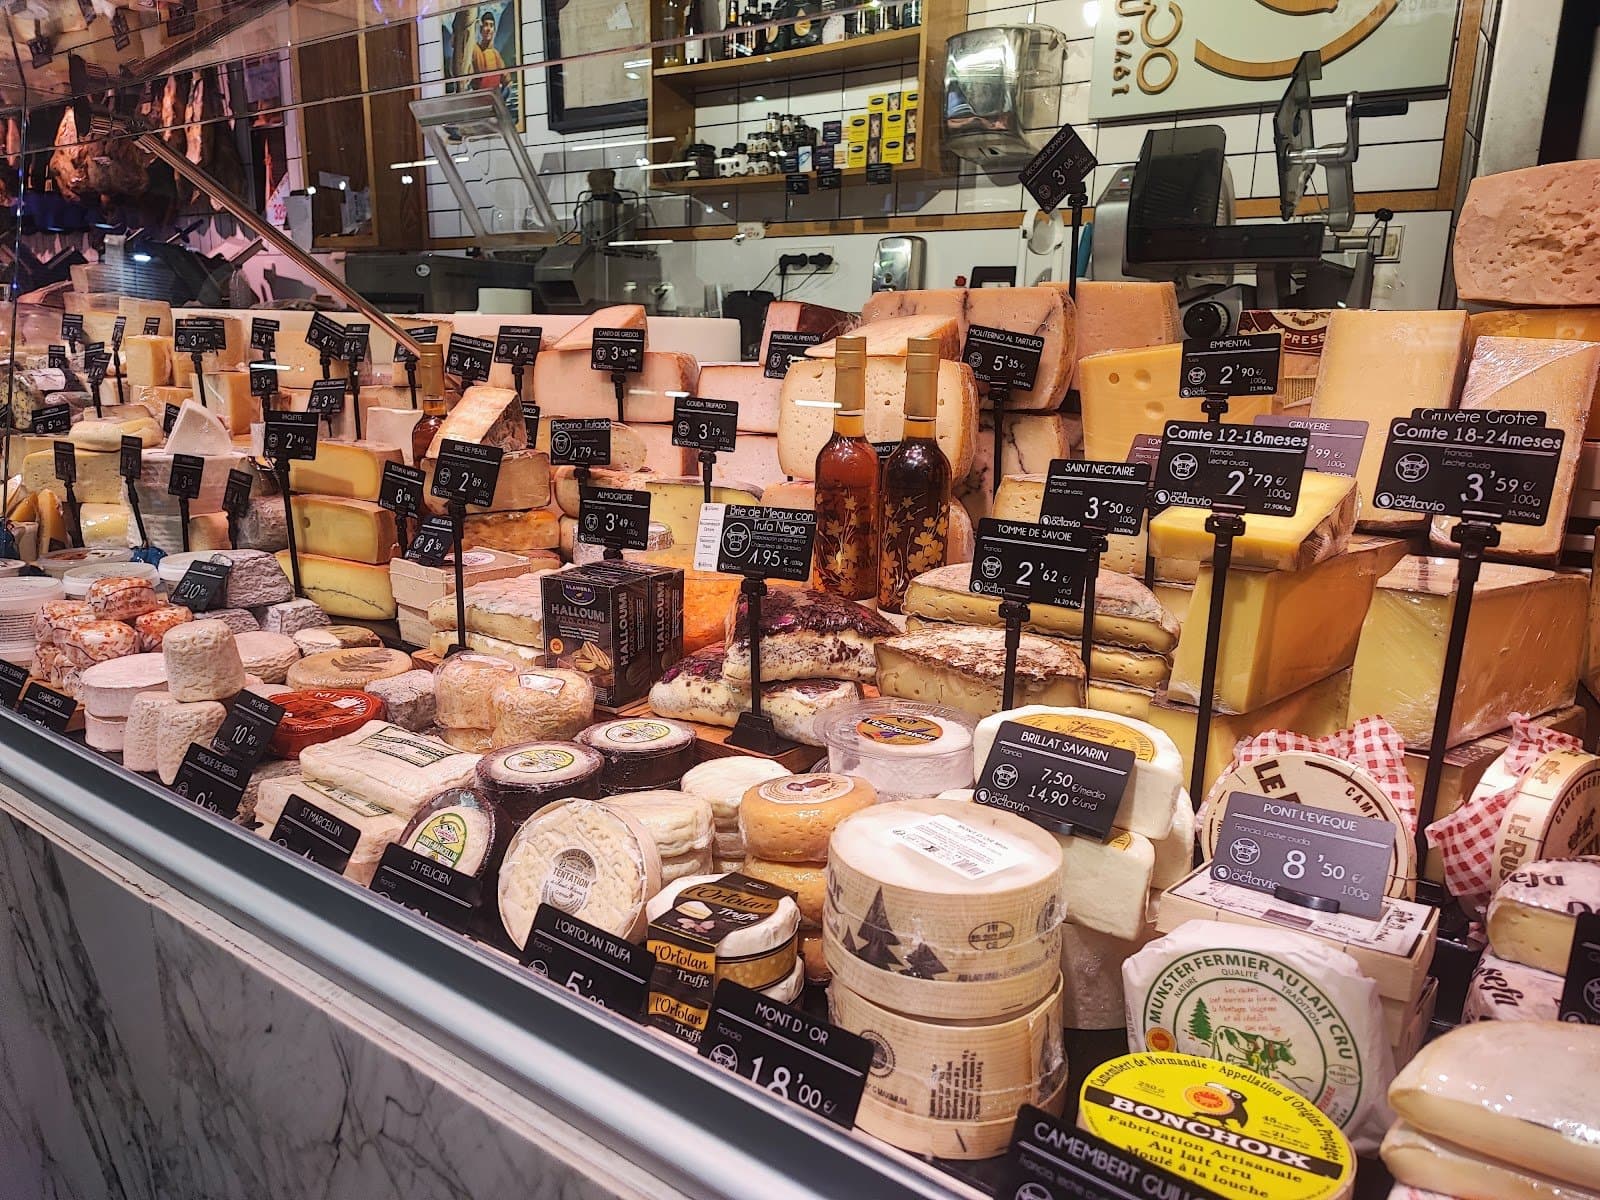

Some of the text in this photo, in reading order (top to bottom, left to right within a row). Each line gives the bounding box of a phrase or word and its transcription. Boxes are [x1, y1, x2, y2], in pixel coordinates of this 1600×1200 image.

[1112, 31, 1134, 97] 1970
[970, 329, 1005, 341] MOLITERNO
[1015, 336, 1042, 348] TARTUFO
[1210, 339, 1252, 349] EMMENTAL
[992, 355, 1019, 371] 5'35
[1219, 364, 1255, 385] 2'90
[1250, 377, 1266, 385] 100g
[705, 402, 727, 410] TRUFADO
[584, 420, 611, 430] Trufado
[698, 422, 721, 440] 3'19
[1288, 421, 1331, 431] GRUYERE
[1167, 425, 1308, 448] Comte 12-18meses
[1393, 423, 1562, 450] Comte 18-24meses
[1065, 463, 1135, 477] SAINT NECTAIRE
[1208, 457, 1228, 465] Leche
[1327, 460, 1345, 469] 100g
[1441, 457, 1466, 467] Leche
[459, 472, 481, 492] 2'89
[1225, 468, 1273, 496] 2'79
[1460, 471, 1519, 502] 3'59
[1169, 492, 1212, 506] octavio
[1266, 488, 1292, 500] 100g
[1394, 496, 1446, 512] octavio
[1511, 493, 1541, 507] 100g
[605, 513, 629, 532] 3'49
[729, 505, 814, 521] Brie de Meaux con
[1051, 517, 1081, 528] octavio
[1118, 515, 1137, 525] 100g
[753, 520, 806, 535] Trufa Negra
[997, 524, 1073, 542] TOMME DE SAVOIE
[1016, 561, 1058, 586] 2'62
[1058, 587, 1072, 596] und
[551, 603, 605, 622] HALLOUMI
[657, 581, 665, 652] HALLOUMI
[619, 592, 628, 666] HALLOUMI
[1000, 747, 1023, 758] Francia
[1021, 731, 1061, 750] BRILLAT
[1062, 741, 1109, 762] SAVARIN
[1040, 768, 1106, 801] 7,50 €/media
[1253, 760, 1287, 794] LE
[1027, 785, 1098, 812] 14,90 €/und
[300, 807, 343, 837] ST MARCELLIN
[1263, 803, 1358, 832] PONT L'EVEQUE
[1507, 813, 1532, 836] LE
[1263, 829, 1287, 841] Leche
[411, 859, 452, 886] ST FELICIEN
[553, 867, 590, 889] TENTATION
[685, 886, 774, 910] l'Ortolan
[1341, 885, 1370, 901] 100g
[717, 907, 760, 921] Truffe
[555, 918, 631, 963] L'ORTOLAN TRUFA
[655, 944, 709, 970] l'Ortolan
[677, 969, 710, 988] Truffe
[655, 997, 703, 1026] l'Ortolan
[1149, 962, 1195, 1024] MUNSTER
[1195, 954, 1270, 973] FERMIER
[1273, 968, 1300, 987] AU
[1299, 985, 1336, 1021] LAIT
[1329, 1021, 1354, 1060] CRU
[1174, 976, 1198, 998] NATURE
[1281, 985, 1322, 1026] TRADITION
[755, 1003, 790, 1028] MONT
[1090, 1061, 1134, 1087] Camembert
[1134, 1058, 1147, 1067] de
[1147, 1056, 1208, 1069] Normandie
[1218, 1065, 1282, 1097] Appellation
[1283, 1094, 1324, 1128] d'Origine
[1109, 1095, 1311, 1170] BONCHOIX
[1034, 1122, 1140, 1185] CAMEMBERT
[1108, 1114, 1302, 1183] Fabrication Artisanale
[1149, 1141, 1251, 1180] Au lait cru
[1126, 1145, 1269, 1198] Moulé à la louche
